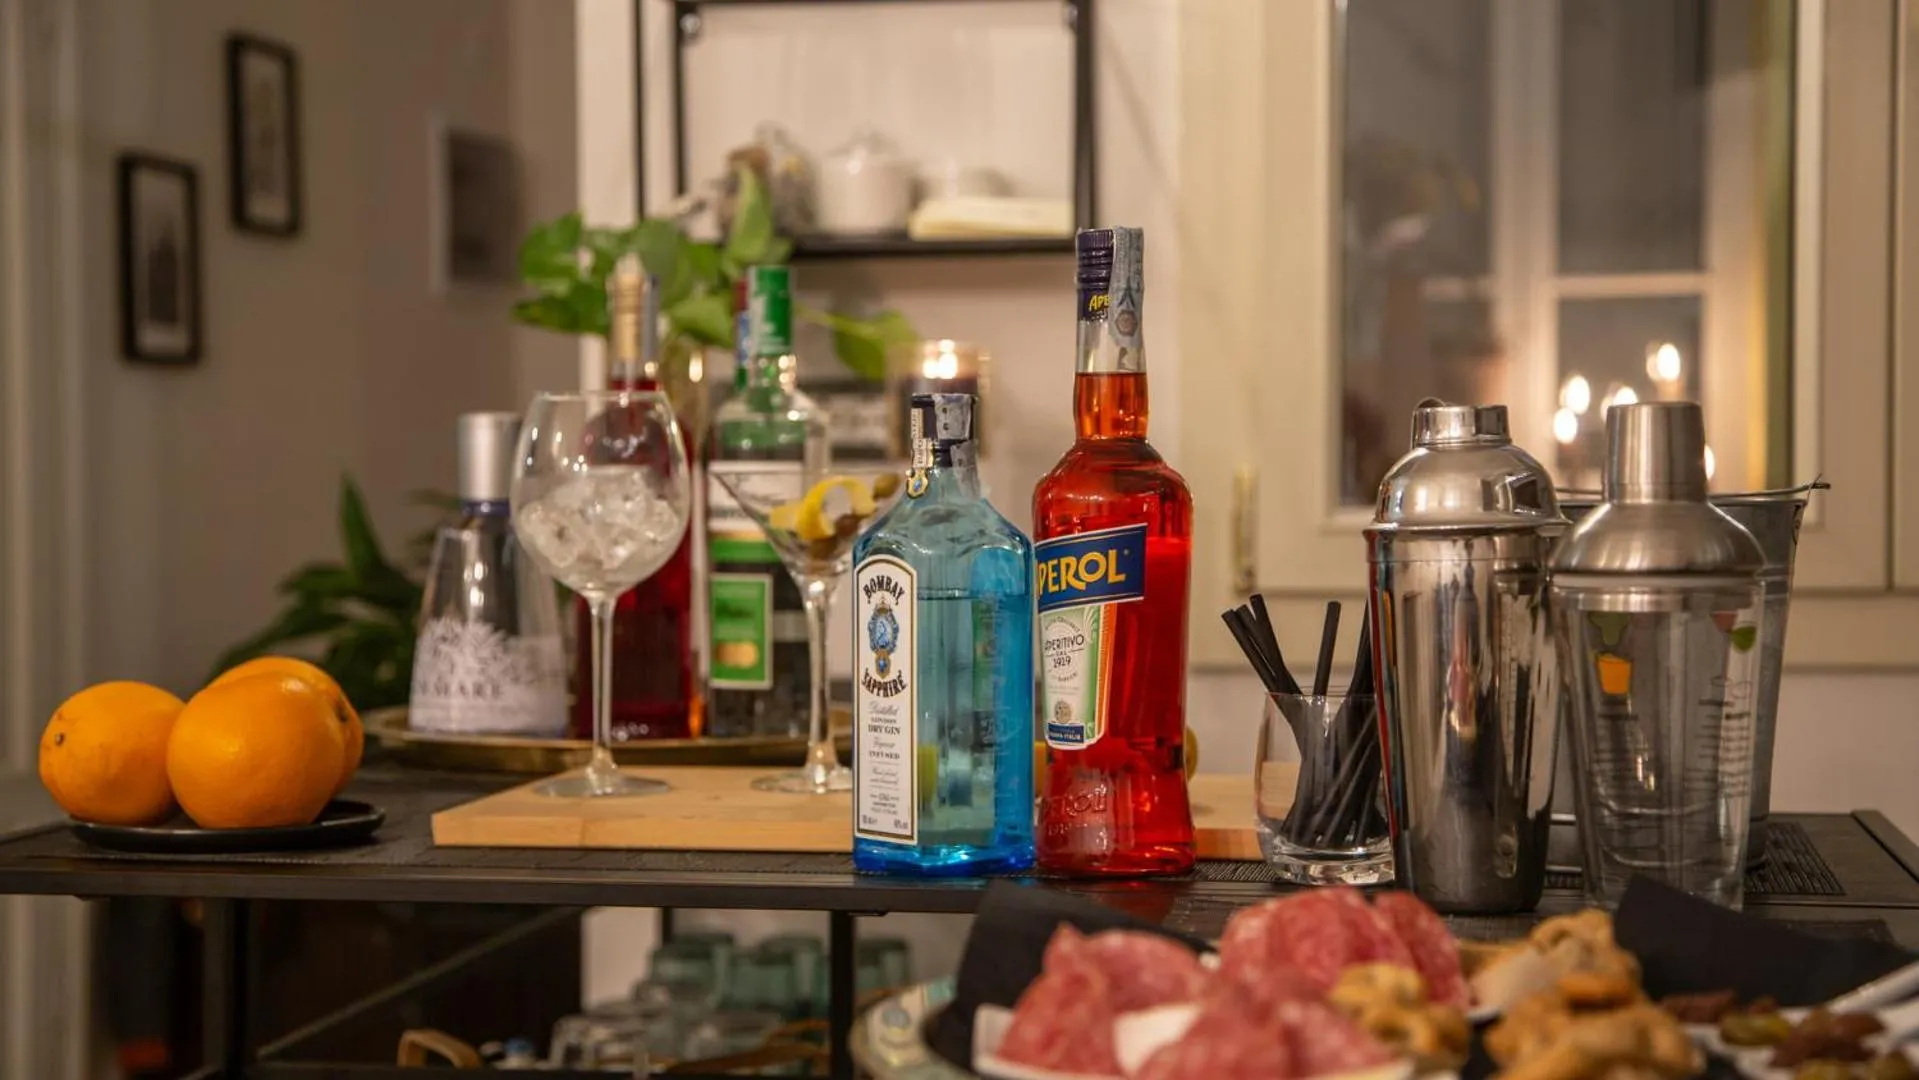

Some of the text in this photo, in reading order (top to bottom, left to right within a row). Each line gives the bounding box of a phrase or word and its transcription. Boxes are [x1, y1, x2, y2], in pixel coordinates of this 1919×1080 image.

[1037, 548, 1126, 596] PEROL
[863, 575, 905, 603] BOMBAY
[1045, 633, 1084, 650] APERITIVO
[1053, 656, 1071, 668] 1919
[862, 669, 907, 698] SAPPHIRE
[868, 724, 901, 735] DRY GIN
